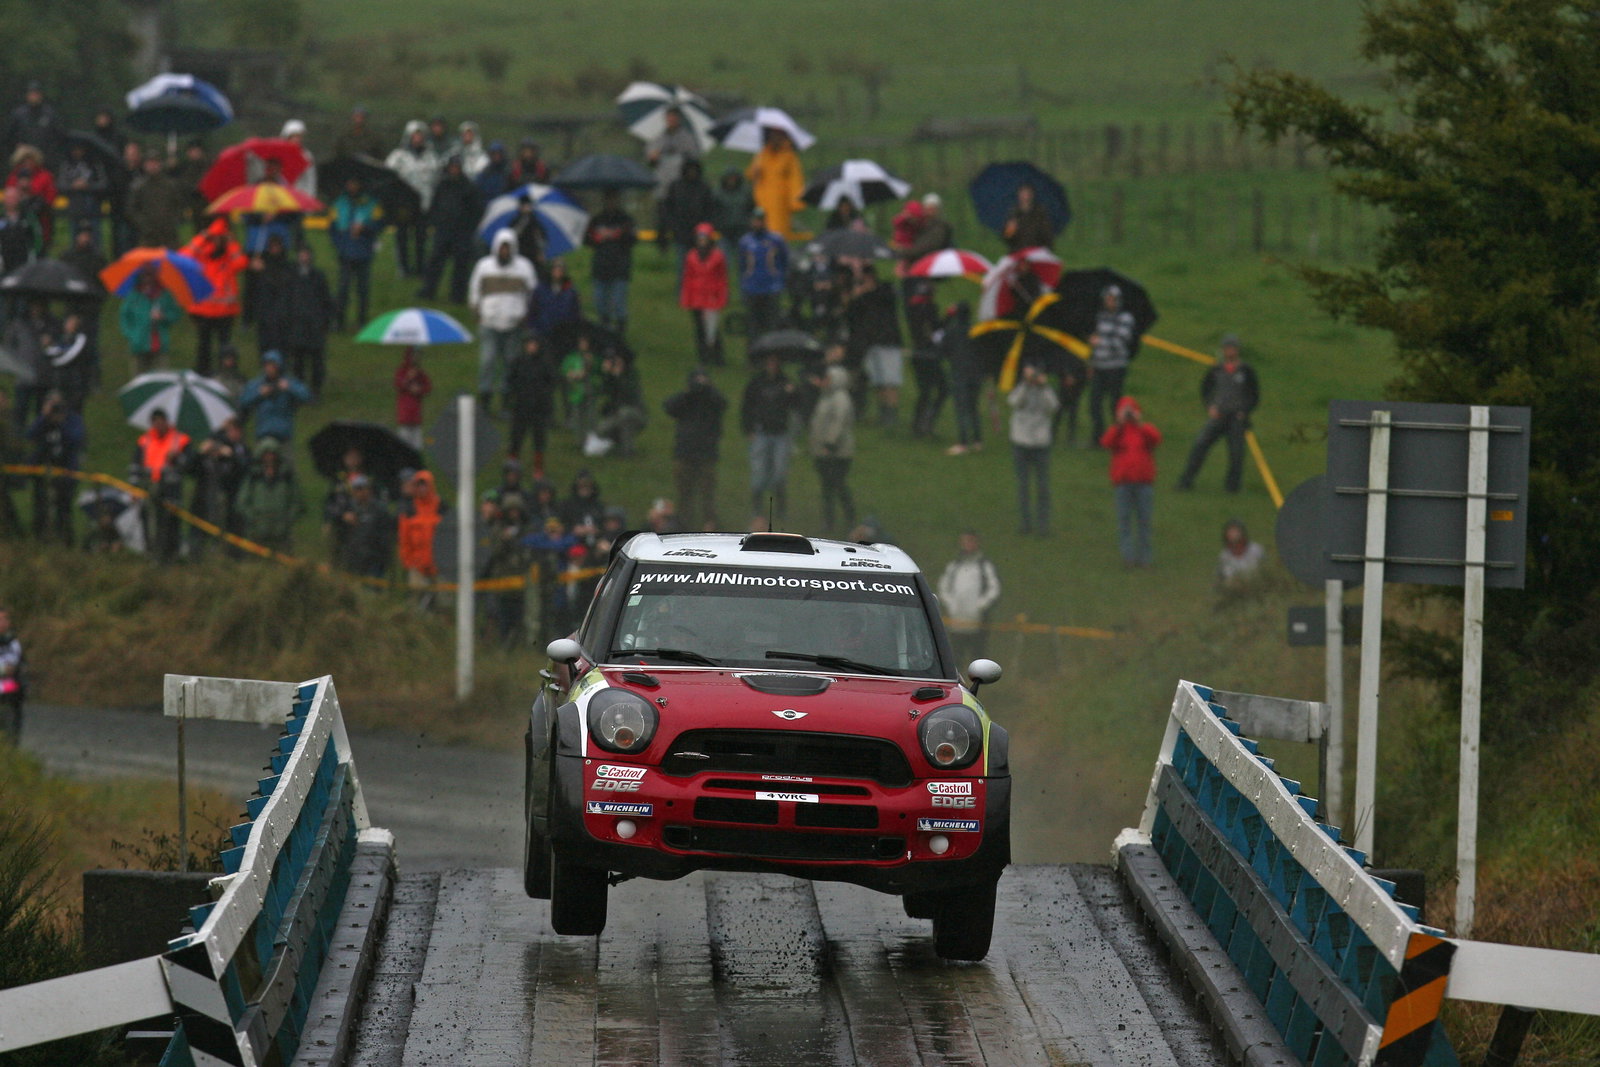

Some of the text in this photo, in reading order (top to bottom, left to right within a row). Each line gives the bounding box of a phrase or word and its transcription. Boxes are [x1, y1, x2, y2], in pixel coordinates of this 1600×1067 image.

[841, 560, 892, 569] LaRoca
[630, 583, 642, 594] 2
[640, 572, 915, 596] www.MINImotorsport.com
[608, 767, 643, 778] Castrol
[591, 778, 644, 792] EDGE
[938, 784, 970, 794] Castrol
[932, 796, 976, 808] EDGE
[604, 804, 650, 812] MICHELIN
